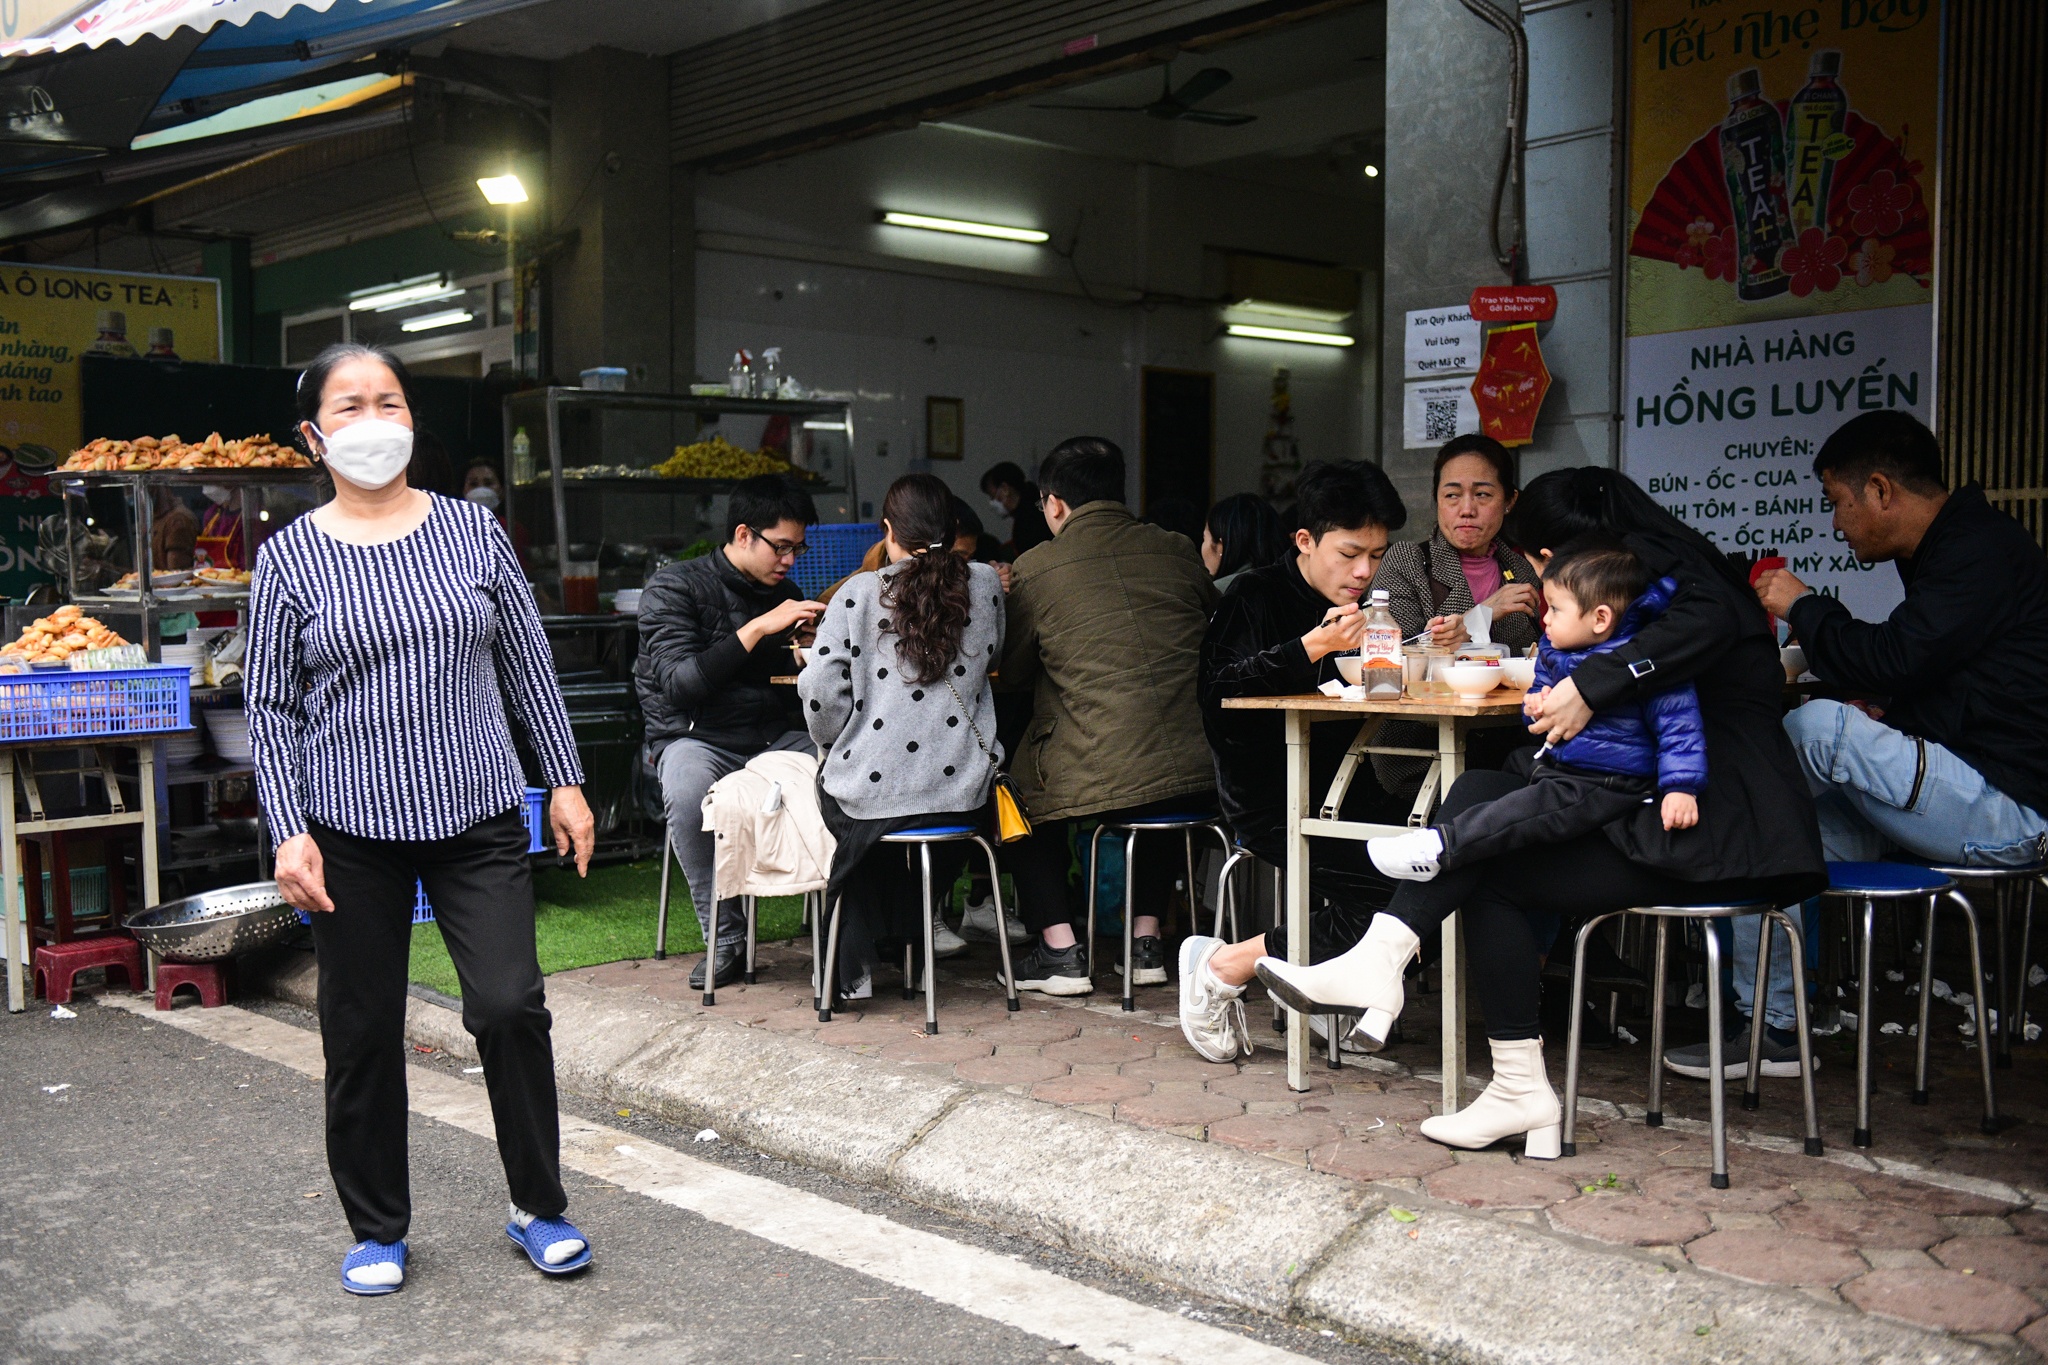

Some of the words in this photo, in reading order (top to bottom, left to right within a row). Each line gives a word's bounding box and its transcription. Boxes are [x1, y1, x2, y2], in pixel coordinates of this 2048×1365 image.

[1642, 17, 1727, 70] Tết
[1733, 8, 1819, 59] nhẹ
[16, 271, 37, 296] Ô
[45, 278, 113, 302] LONG
[120, 284, 173, 307] TEA
[1414, 316, 1428, 326] Xin
[1448, 312, 1473, 323] Khách
[1425, 338, 1439, 347] Vui
[1440, 336, 1460, 347] Lòng
[1691, 335, 1754, 370] NHÀ
[1765, 329, 1856, 362] HÀNG
[1418, 359, 1437, 371] Quét
[1439, 358, 1452, 368] Mã
[1453, 356, 1466, 367] QR
[29, 386, 63, 403] tao
[1636, 376, 1756, 428] HỒNG
[1772, 357, 1918, 417] LUYẾN
[1724, 436, 1815, 461] CHUYÊN:
[1649, 472, 1688, 494] BÚN
[1706, 466, 1736, 491] ỐC
[1755, 469, 1798, 488] CUA
[1692, 498, 1735, 519] TÔM
[1755, 495, 1814, 516] BÁNH
[1735, 520, 1765, 546] ỐC
[1771, 520, 1814, 544] HẤP
[1793, 552, 1824, 573] MỲ
